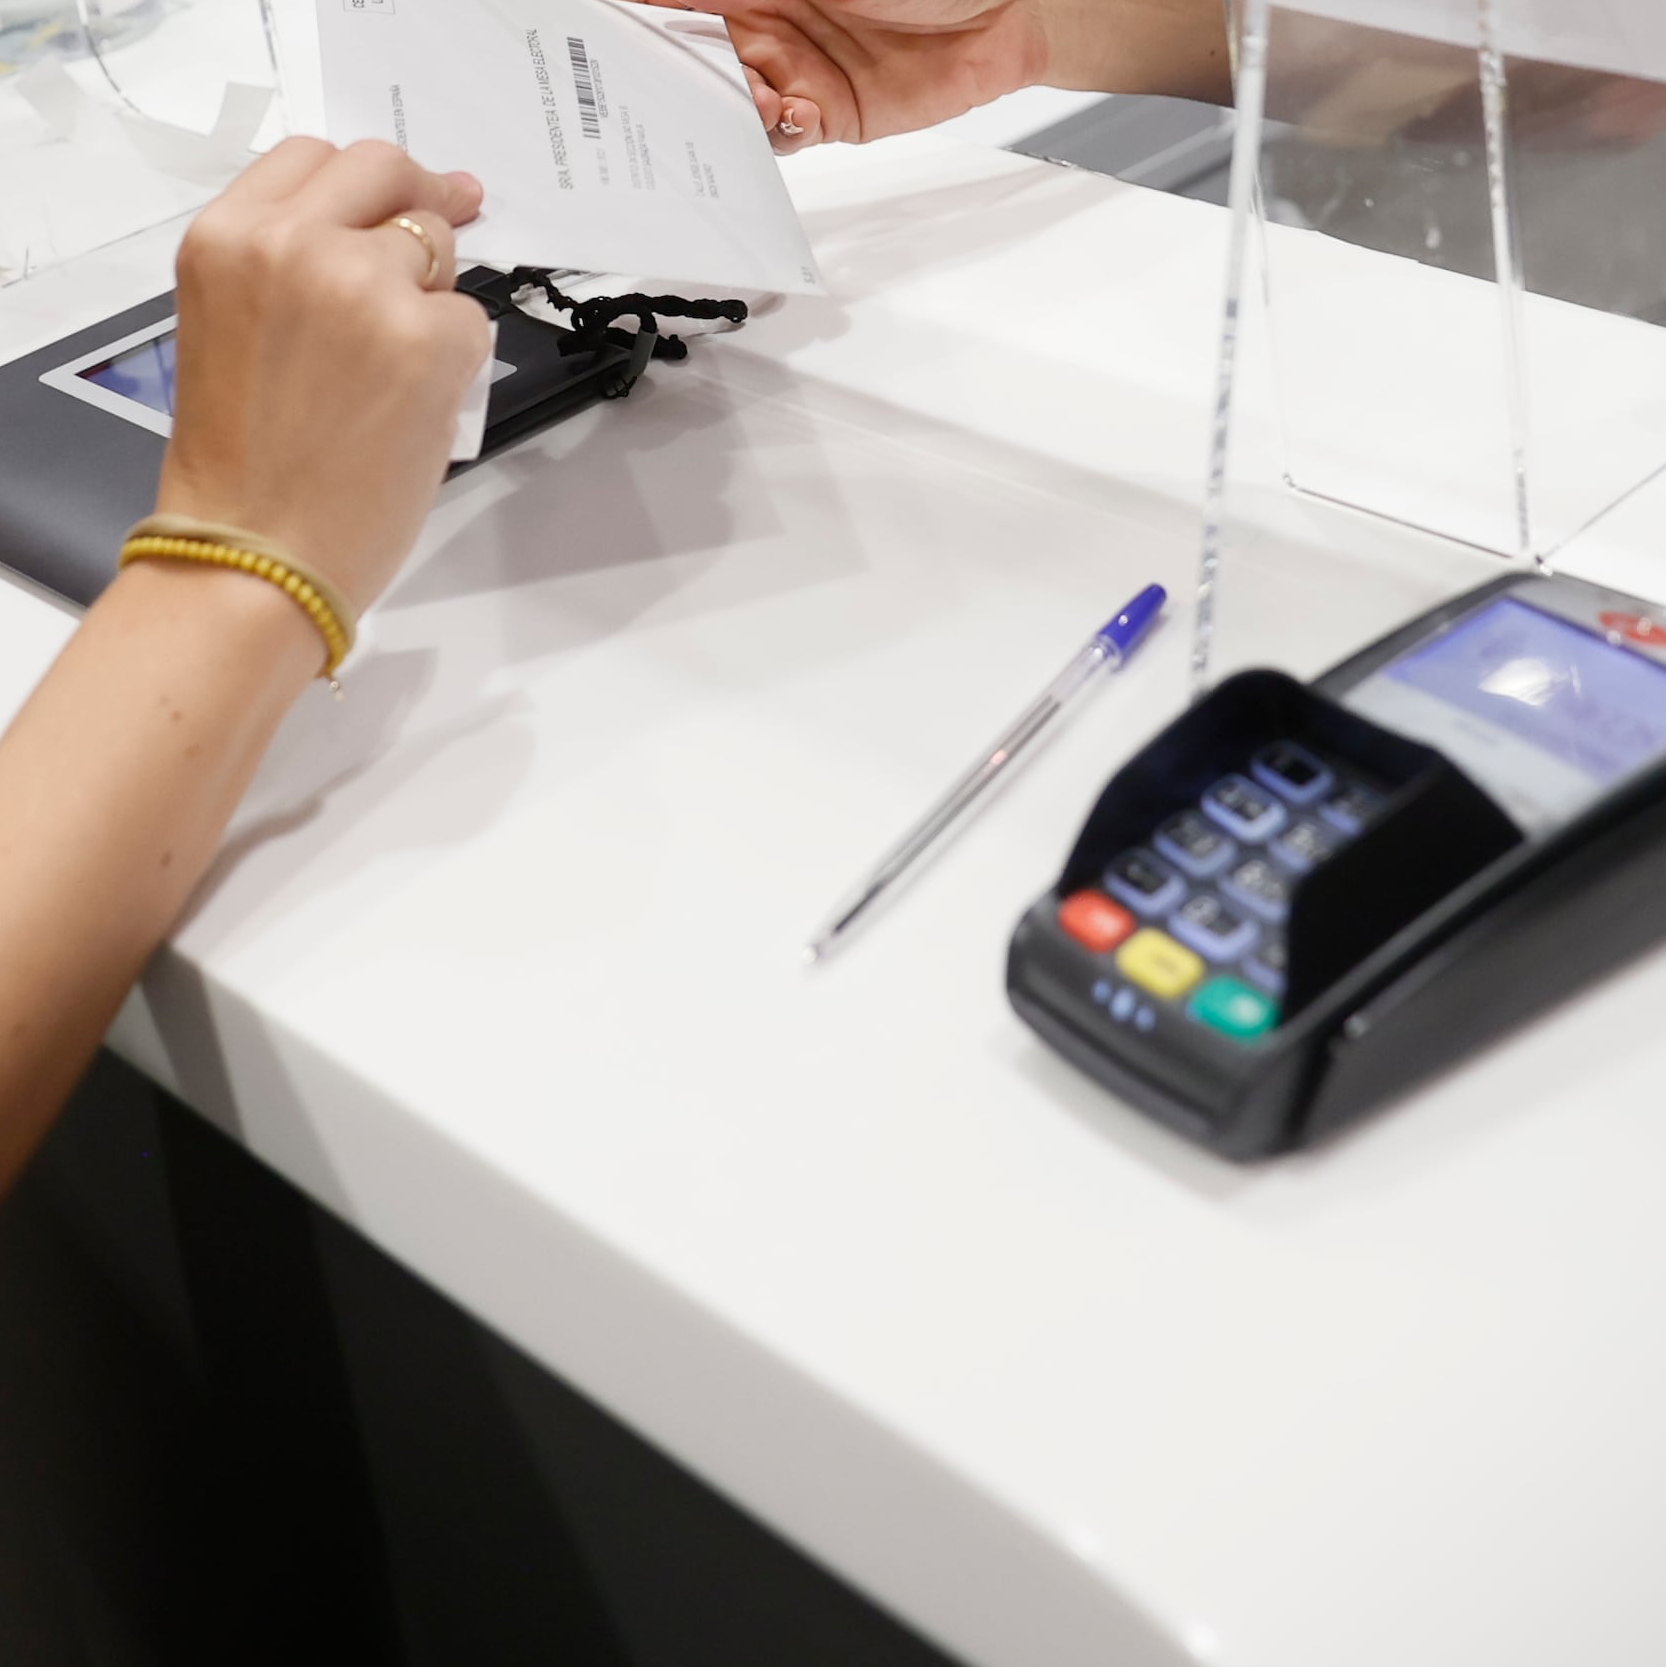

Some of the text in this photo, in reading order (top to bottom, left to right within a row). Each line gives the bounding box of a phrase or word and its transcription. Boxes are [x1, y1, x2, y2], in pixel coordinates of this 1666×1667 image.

[526, 28, 546, 65] ELECTORAL
[535, 66, 550, 85] MESA
[541, 96, 556, 107] DE
